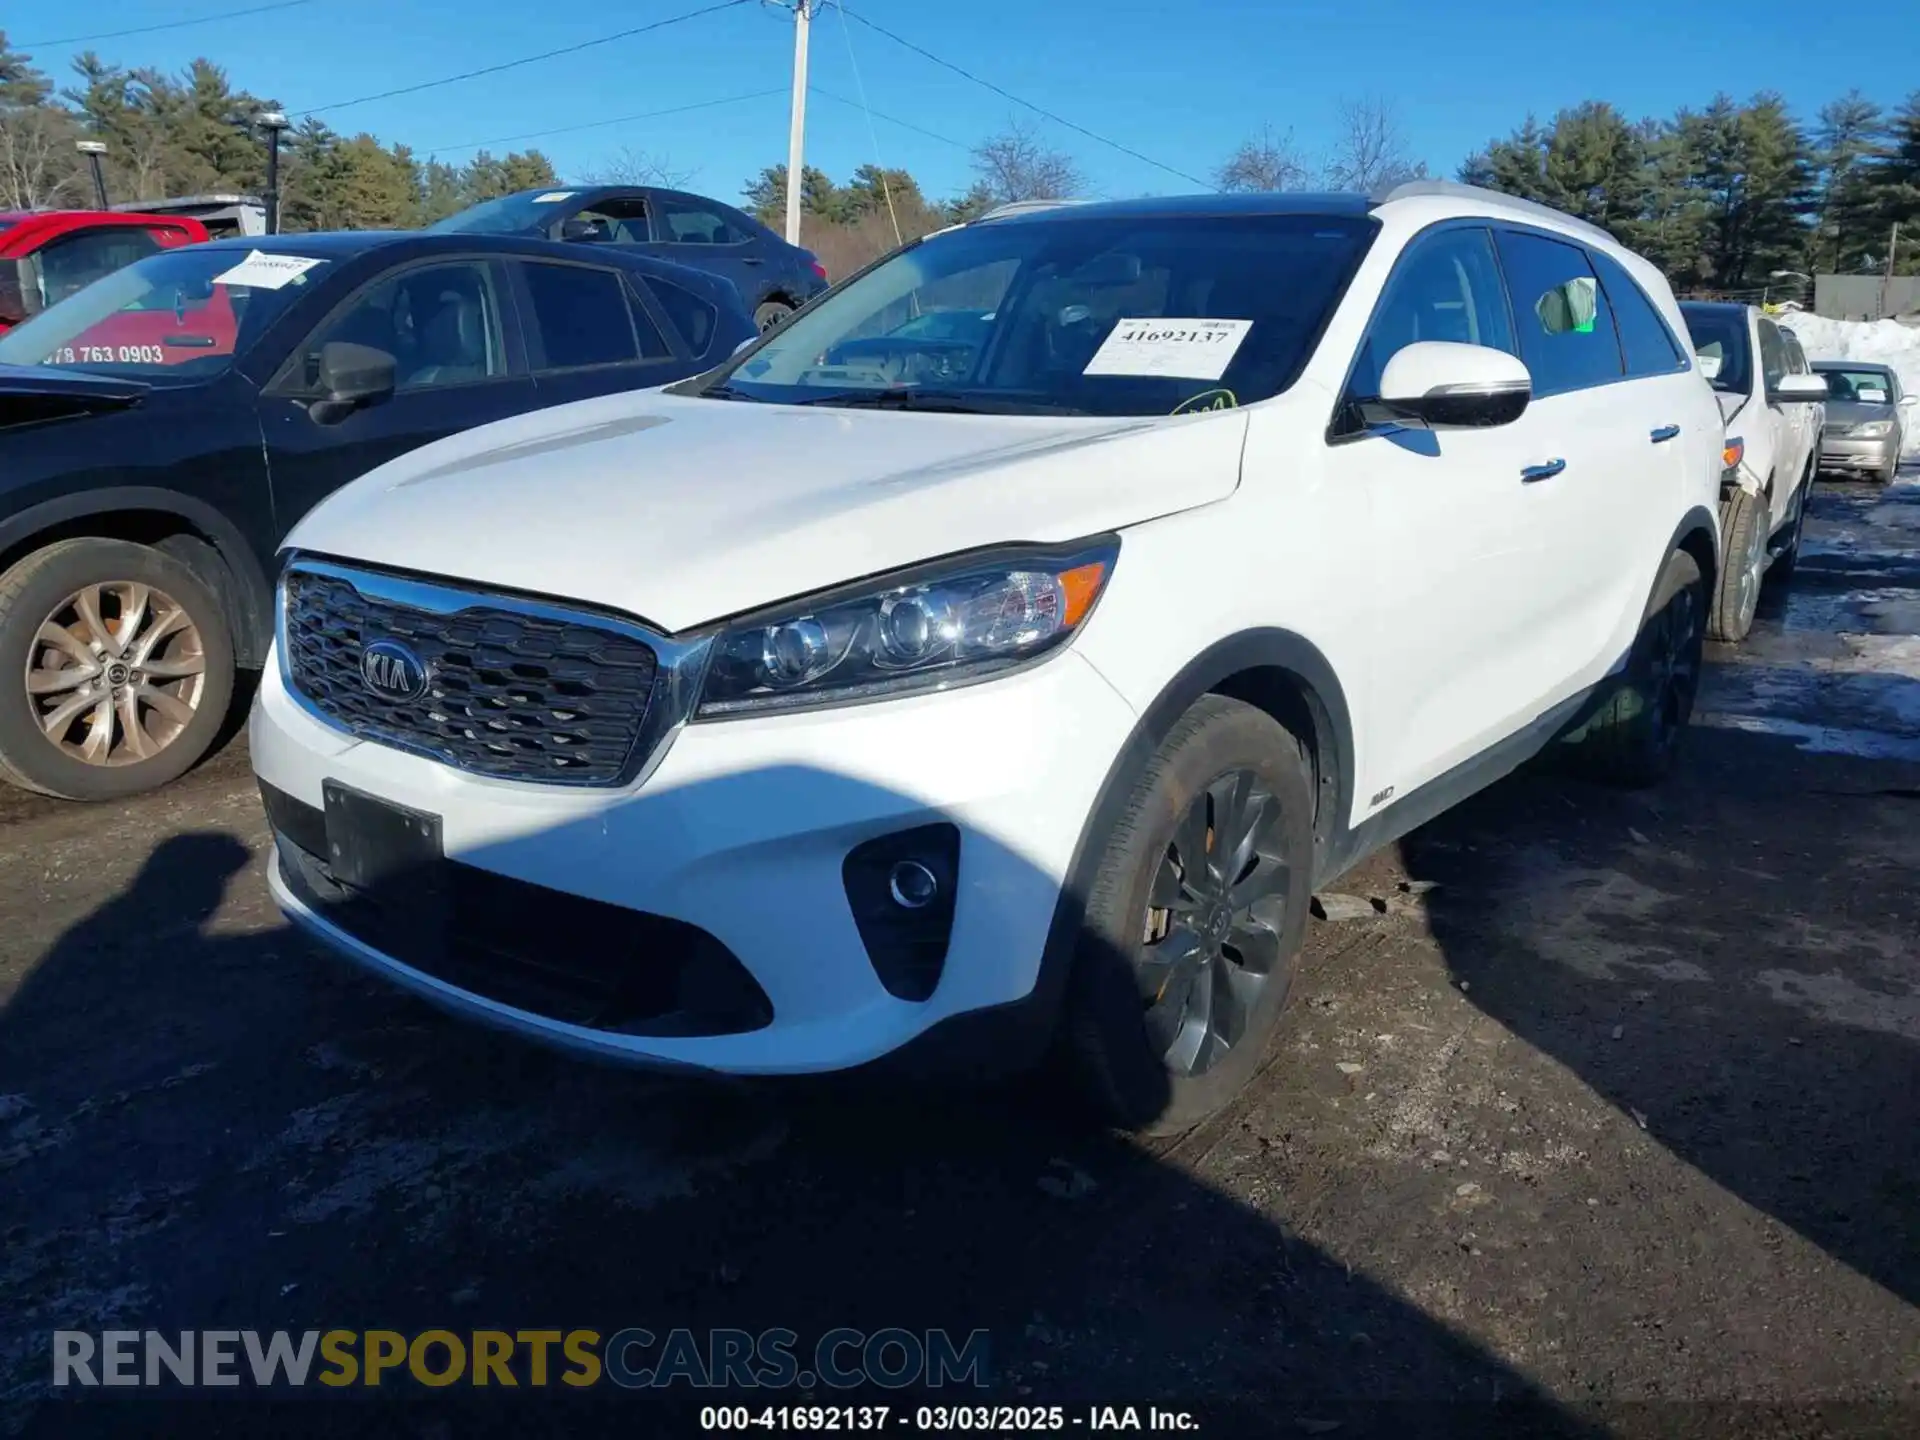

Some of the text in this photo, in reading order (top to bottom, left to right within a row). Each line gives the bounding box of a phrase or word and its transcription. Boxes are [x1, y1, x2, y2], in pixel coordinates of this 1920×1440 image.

[1120, 330, 1228, 344] 41692137
[80, 346, 115, 363] 763
[119, 344, 163, 364] 0903
[366, 651, 409, 691] KIA
